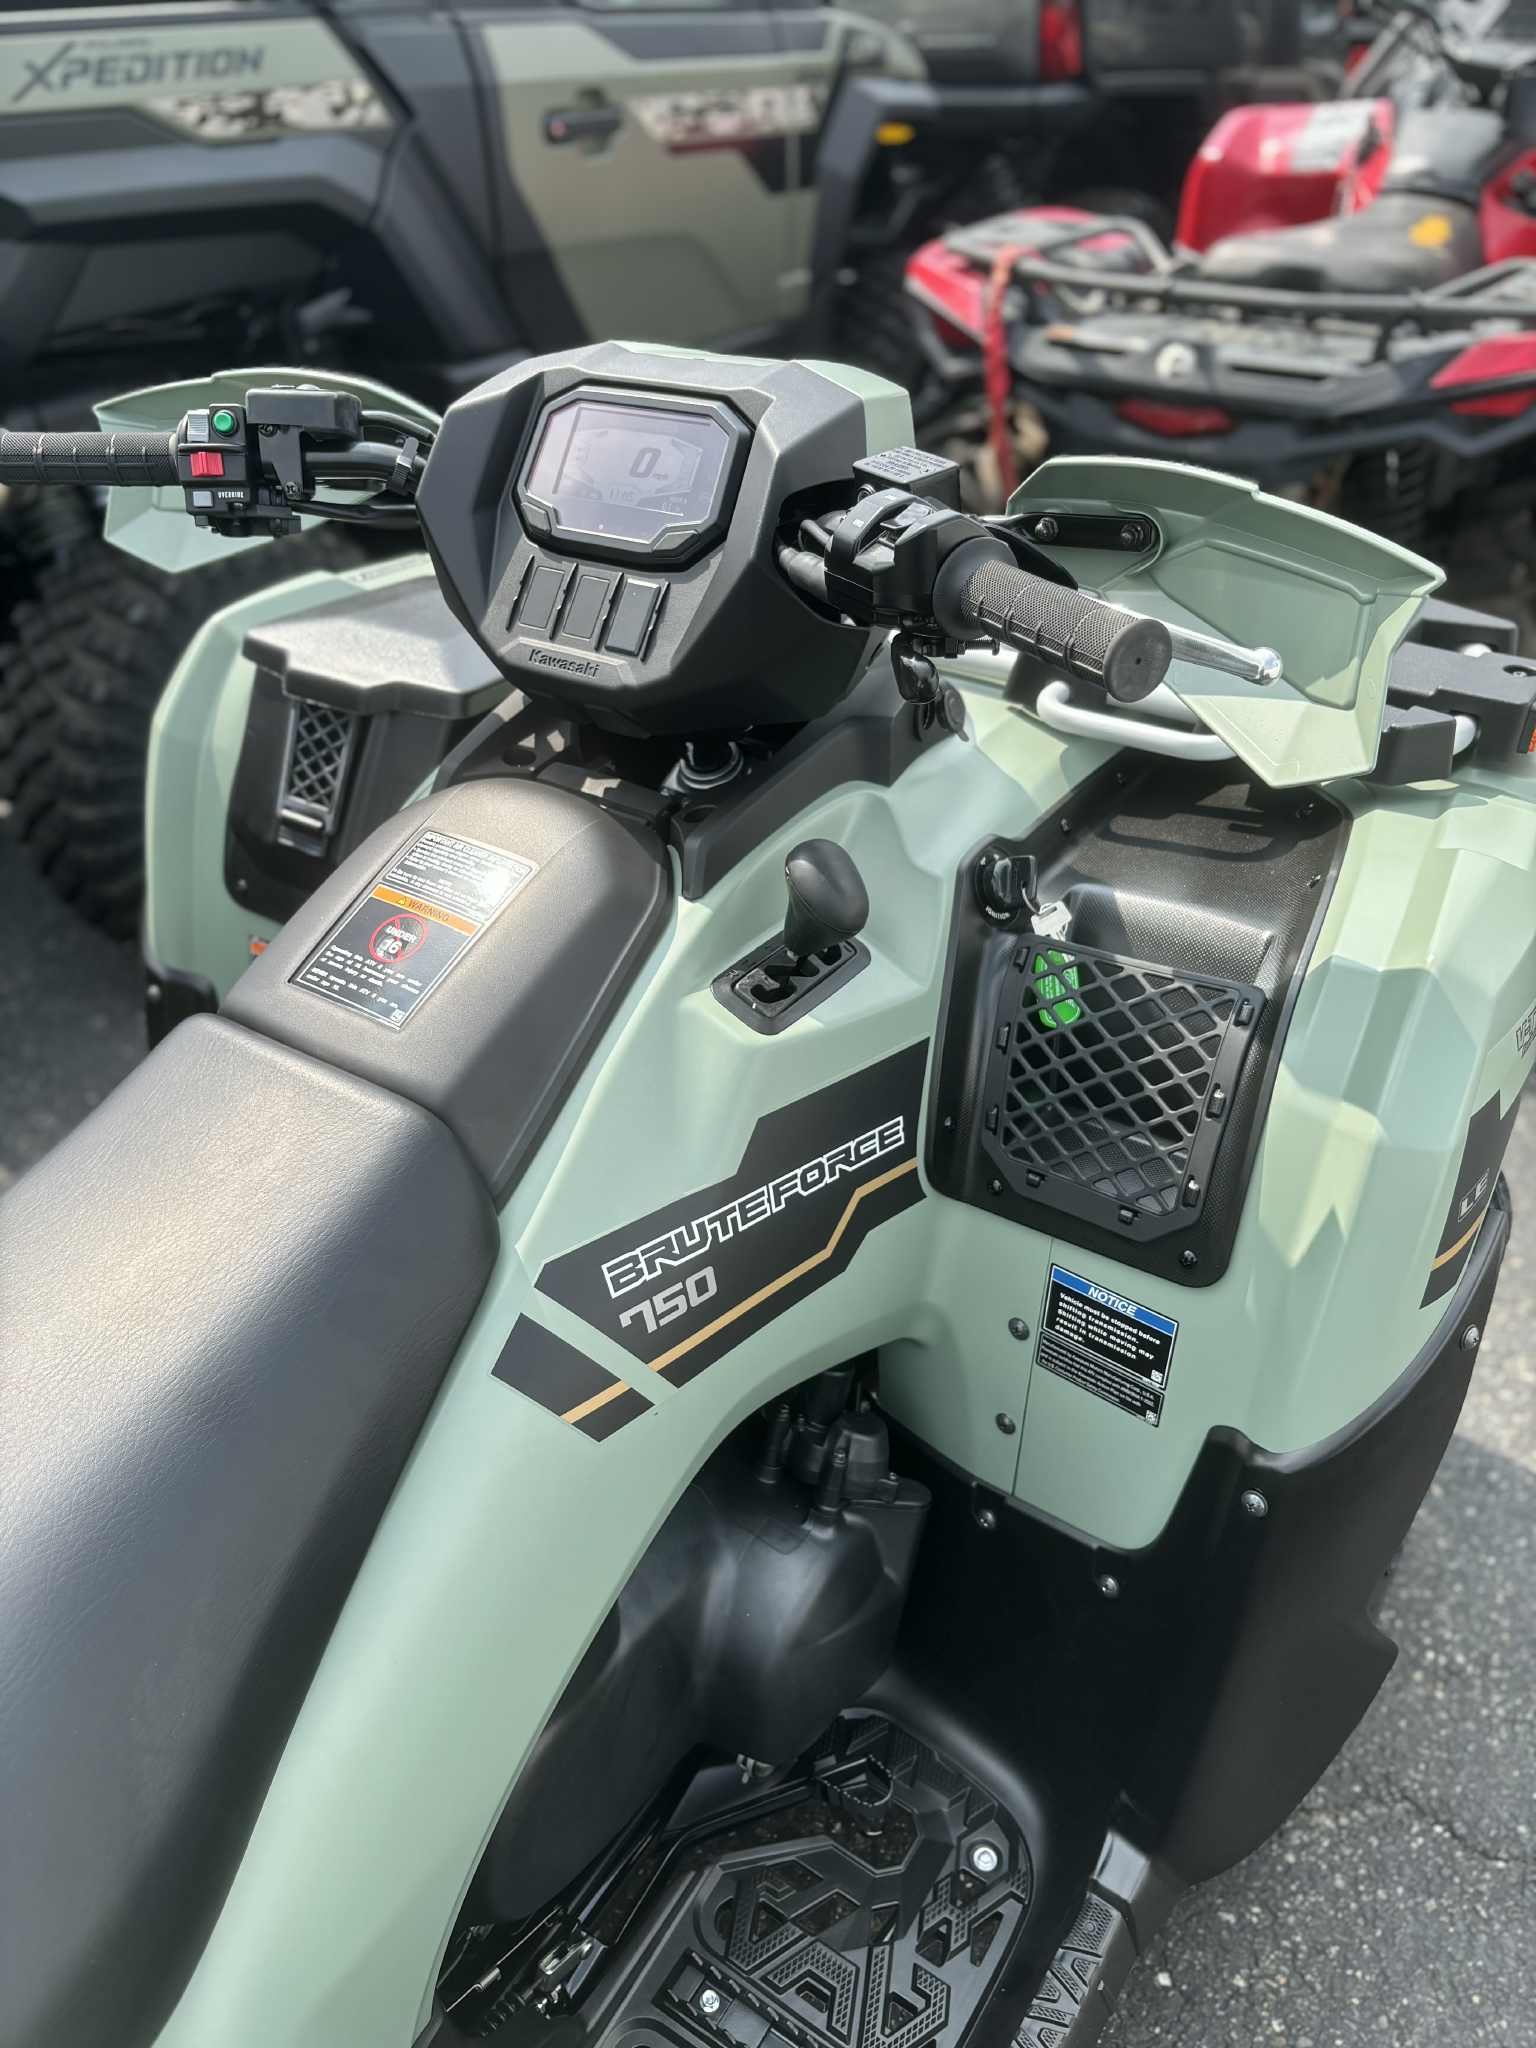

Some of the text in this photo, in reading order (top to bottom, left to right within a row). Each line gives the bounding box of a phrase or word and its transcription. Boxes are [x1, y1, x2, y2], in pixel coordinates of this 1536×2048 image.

[11, 41, 266, 102] XPEDITION
[629, 447, 661, 478] 0
[528, 649, 600, 678] Kawasaki
[409, 901, 449, 920] WARNING
[380, 938, 402, 954] 16
[386, 926, 417, 944] UNDER
[619, 1266, 718, 1333] 750
[1059, 1301, 1087, 1319] shifting
[1088, 1287, 1137, 1317] NOTICE
[1060, 1292, 1161, 1345] Vehicle must be stopped before
[1056, 1317, 1137, 1360] result in transmission
[1057, 1309, 1155, 1360] Shifting while moving may
